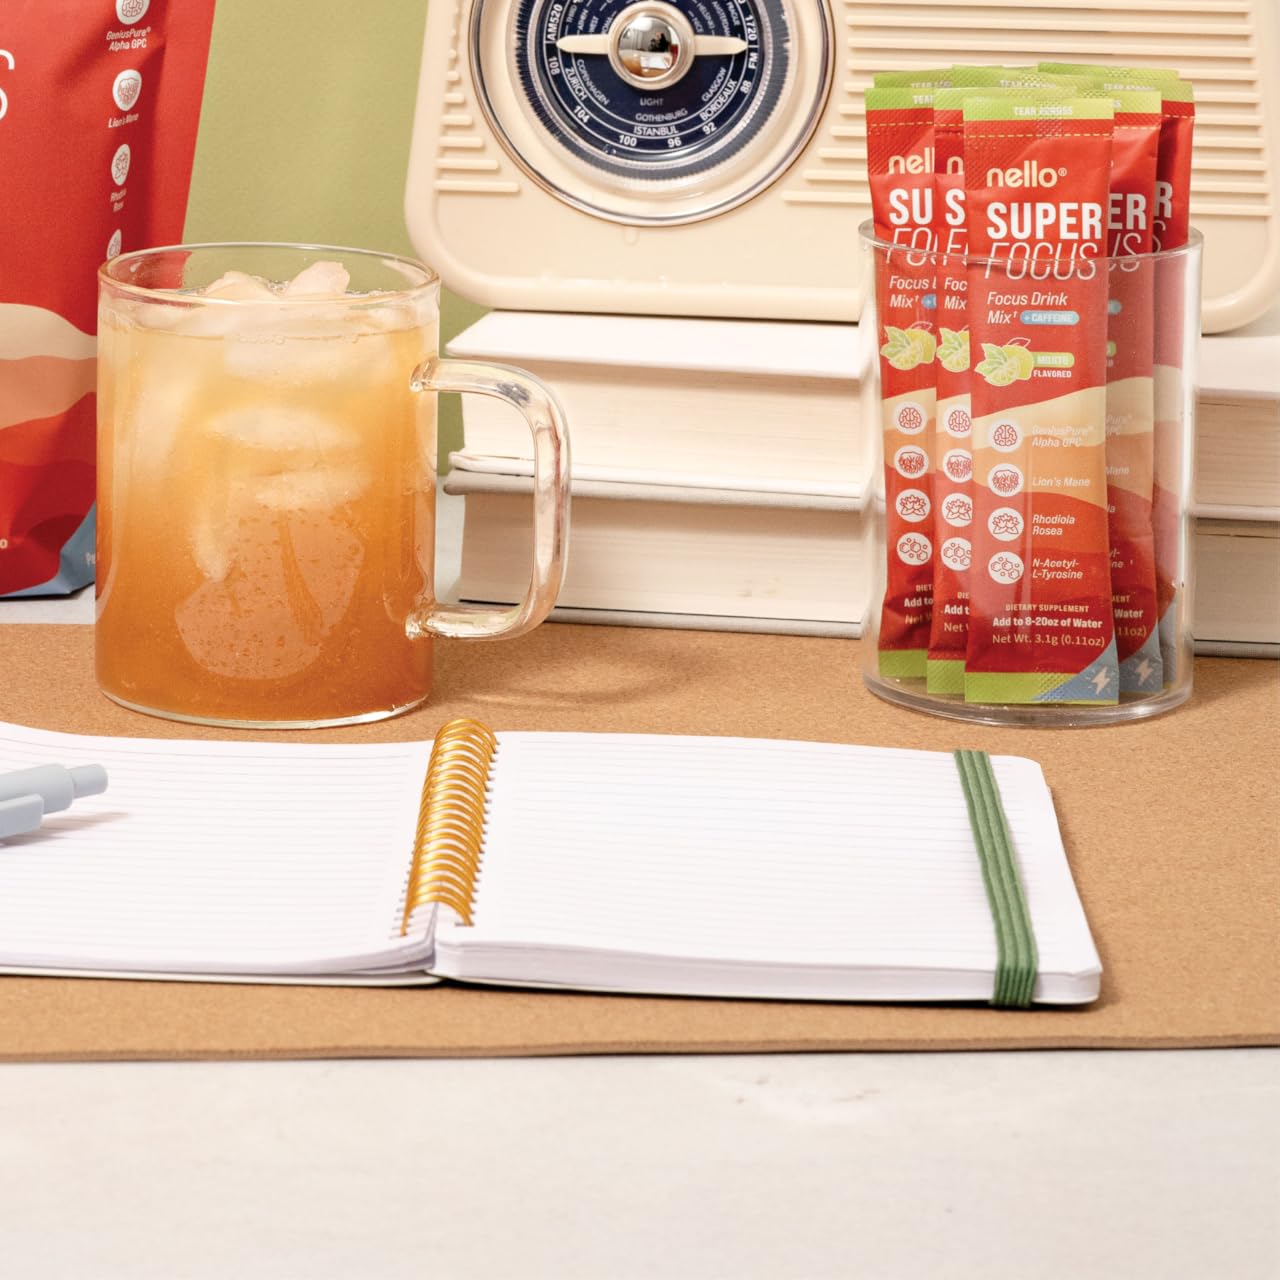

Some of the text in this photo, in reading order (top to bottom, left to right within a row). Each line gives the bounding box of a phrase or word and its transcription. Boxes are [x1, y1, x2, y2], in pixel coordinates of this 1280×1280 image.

[745, 15, 758, 41] 1720
[109, 38, 147, 52] Alpha GPC
[548, 52, 759, 75] 108 FM
[576, 58, 610, 106] COPENHAGEN
[701, 67, 727, 102] GLASGOW
[639, 97, 664, 107] LIGHT
[699, 78, 737, 121] BORDEAUX
[573, 80, 752, 148] 104 100 96 92 88
[635, 108, 688, 122] GOTHENBURG
[633, 124, 679, 137] ISTANBUL
[888, 147, 935, 175] nell
[986, 202, 1103, 241] SUPER
[984, 241, 1099, 281] FOCUS
[889, 275, 929, 290] Focus
[944, 277, 968, 291] Foc
[987, 291, 1068, 306] Focus Drink
[1033, 369, 1072, 379] FLAVORED
[1032, 436, 1060, 450] Alpha
[1064, 477, 1090, 488] Mane
[1032, 514, 1076, 525] Rhodiola
[1032, 525, 1063, 536] Rosea
[1032, 558, 1080, 571] N-Acetyl-
[1032, 569, 1084, 581] L-Tyrosine
[904, 598, 922, 608] Add
[944, 604, 963, 615] Add
[1005, 603, 1089, 613] DIETARY SUPPLEMENT
[944, 622, 963, 633] Net
[992, 617, 1103, 629] Add to 8-20oz of Water
[992, 634, 1105, 647] Net Wt. 3.1g (0.11oz)
